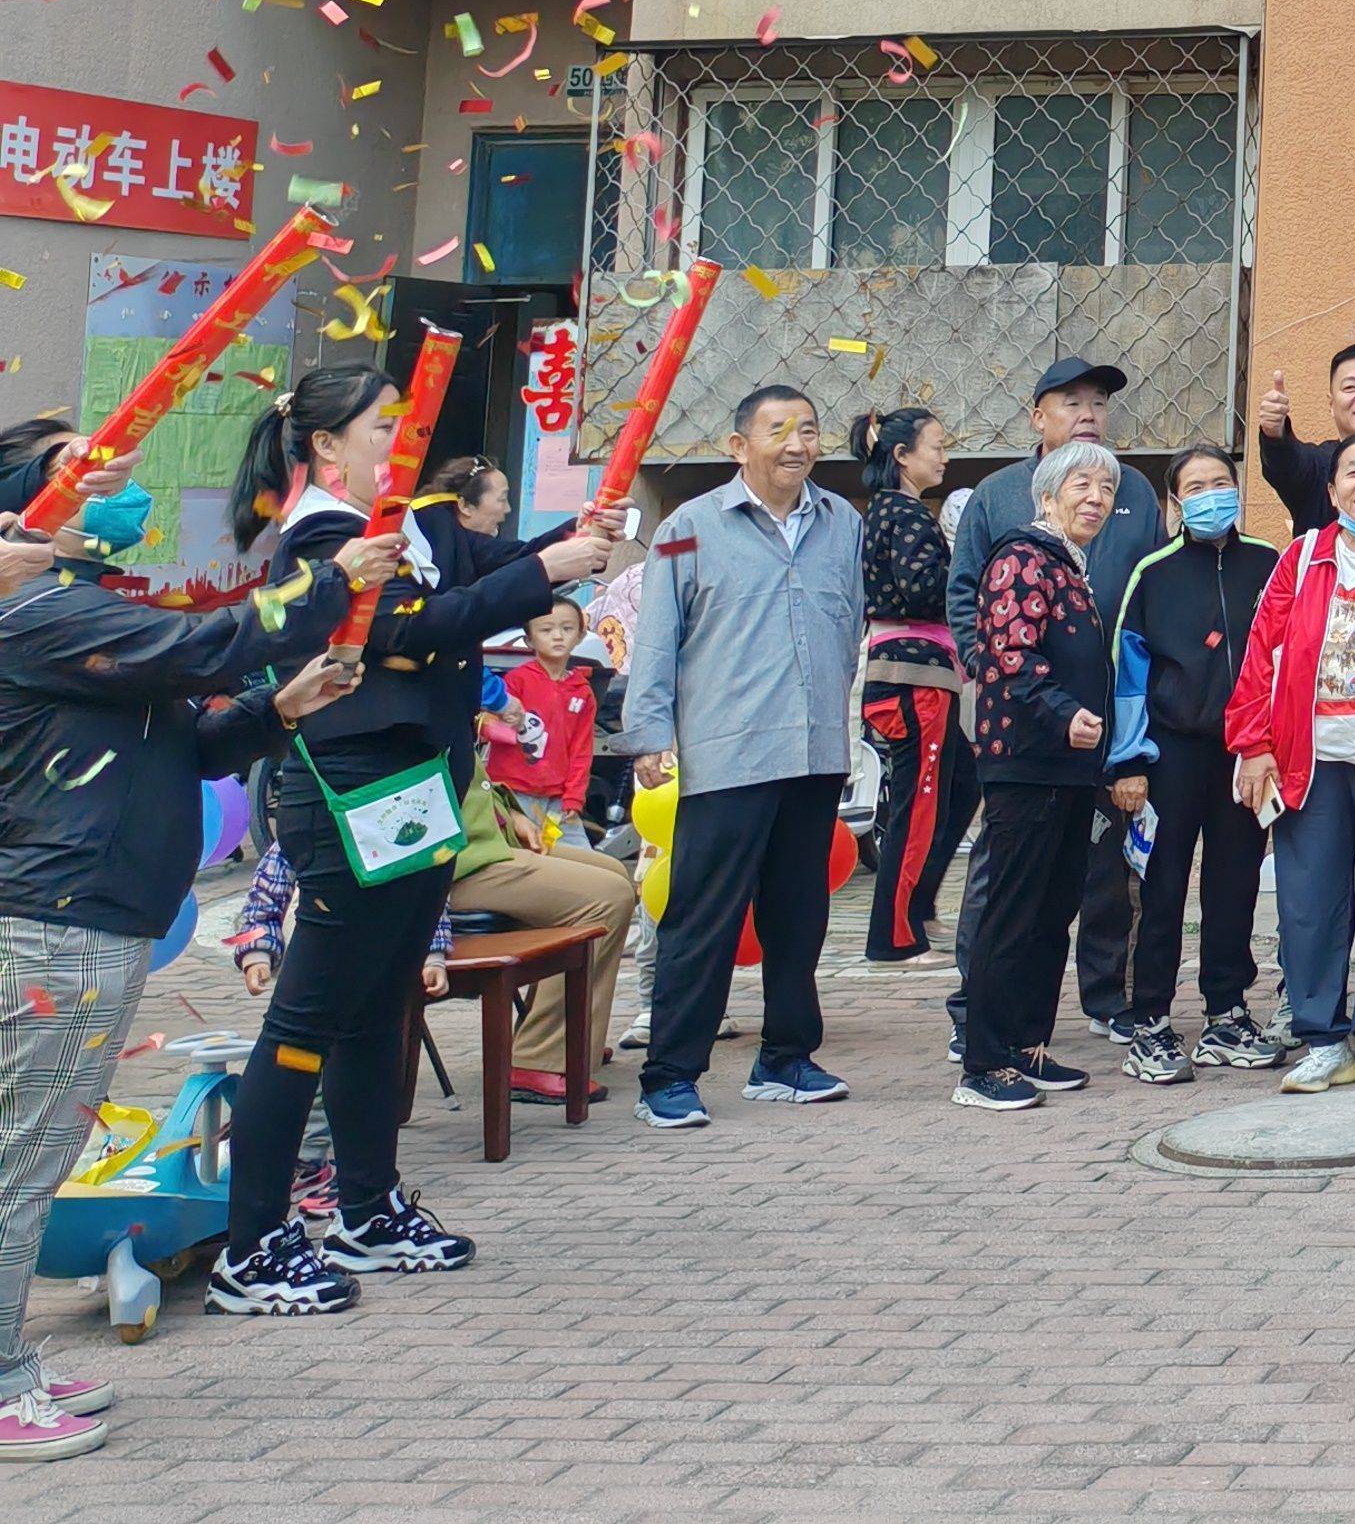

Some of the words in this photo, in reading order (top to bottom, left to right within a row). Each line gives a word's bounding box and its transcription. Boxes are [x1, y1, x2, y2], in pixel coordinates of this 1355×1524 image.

[0, 115, 242, 210] 电动车上楼
